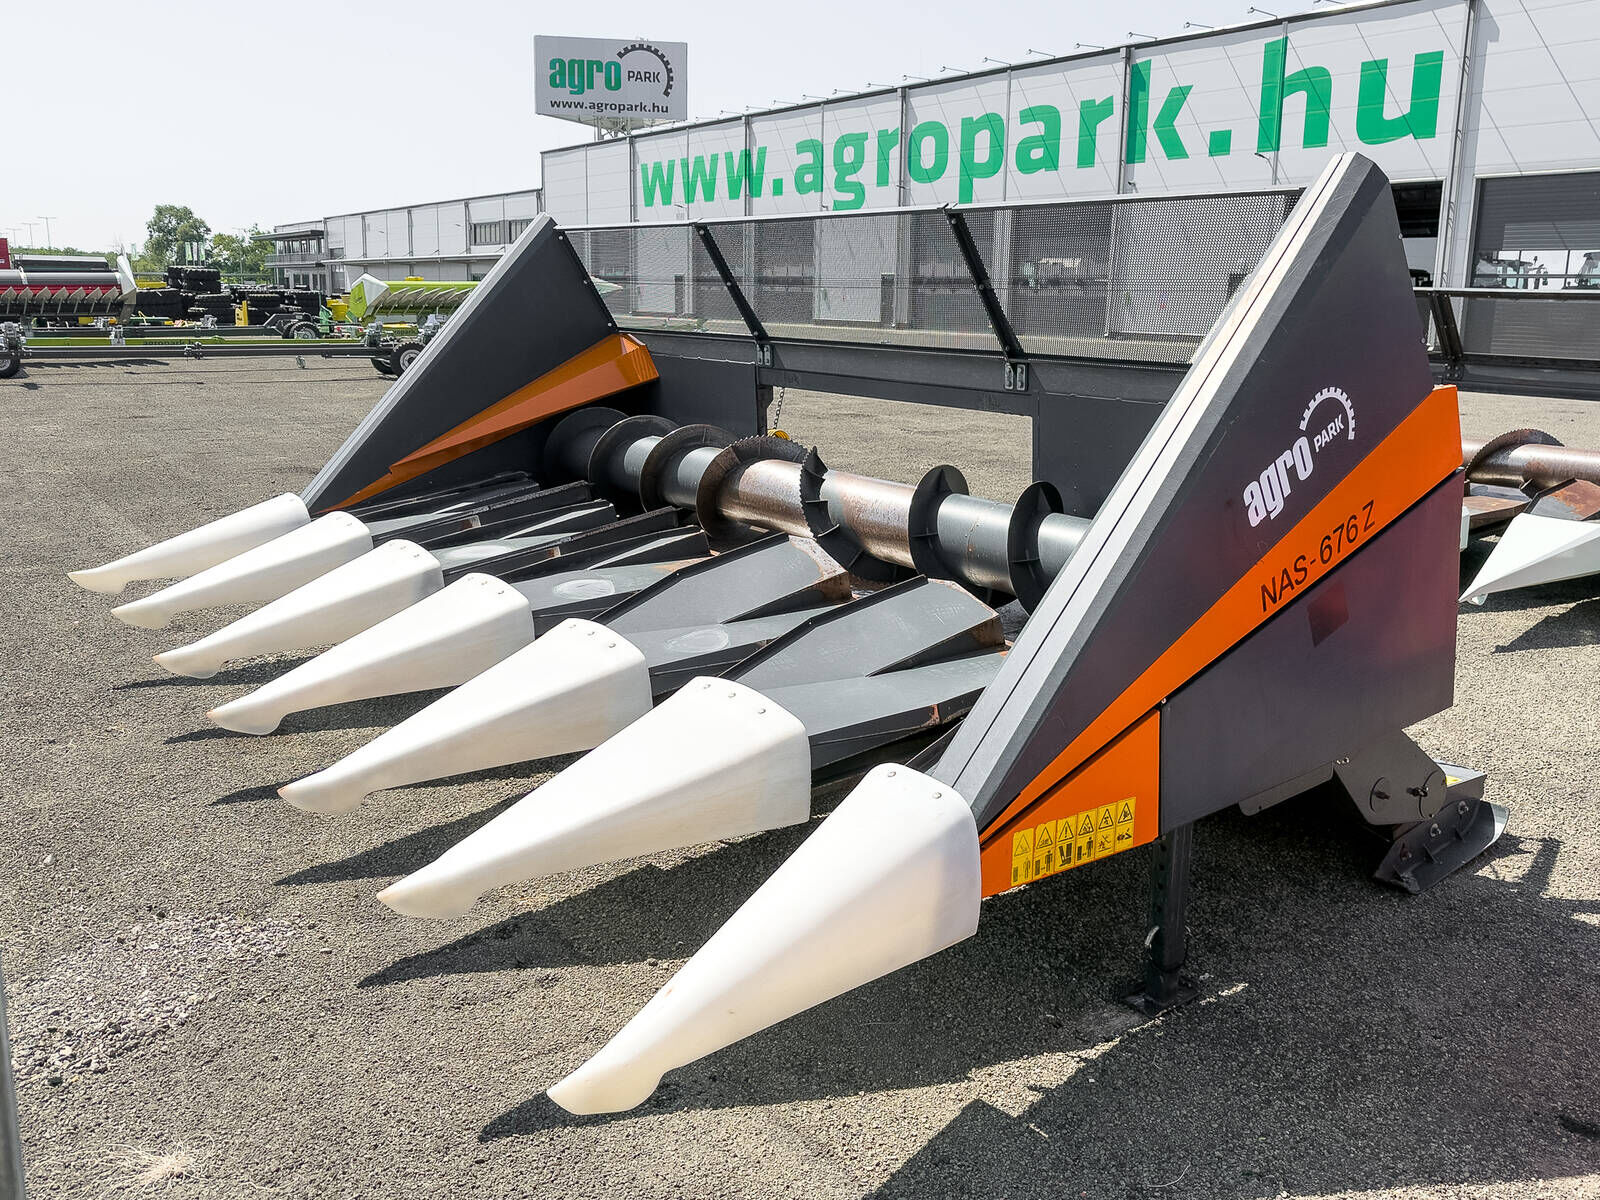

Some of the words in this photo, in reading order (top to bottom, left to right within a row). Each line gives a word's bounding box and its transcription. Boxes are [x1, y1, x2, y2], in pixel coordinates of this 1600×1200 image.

[550, 58, 621, 95] agro
[628, 70, 661, 84] PARK
[550, 100, 669, 114] www.agropark.hu
[641, 37, 1444, 211] www.agropark.hu
[1243, 436, 1314, 528] agro
[1313, 414, 1344, 453] PARK
[1362, 500, 1376, 533] Z
